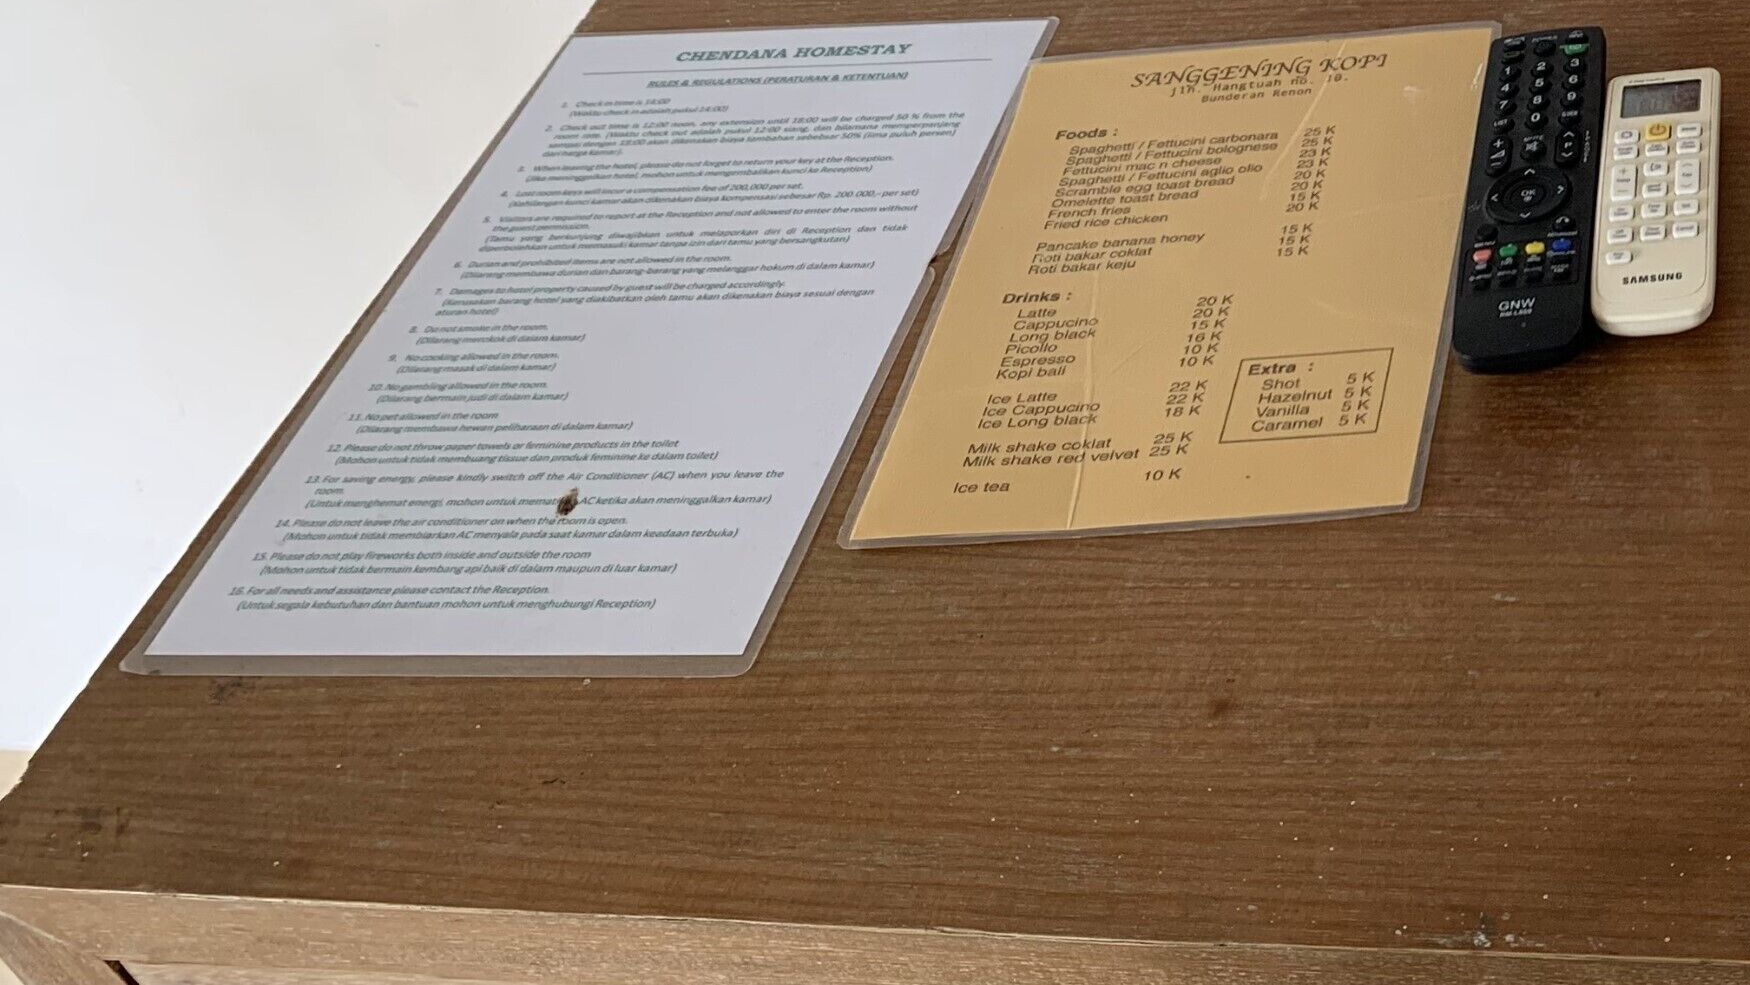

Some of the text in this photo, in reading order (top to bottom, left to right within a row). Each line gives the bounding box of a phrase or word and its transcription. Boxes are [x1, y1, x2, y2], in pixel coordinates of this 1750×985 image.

[675, 43, 913, 63] CHENDANA HOMESTAY
[1129, 53, 1389, 89] SANGGENING KOPI
[1505, 58, 1580, 75] 1 2 3
[645, 79, 681, 89] RULES
[688, 76, 763, 88] REGULATIONS
[762, 74, 830, 85] (PERATURAN
[842, 71, 910, 83] KETENTUAN)
[1212, 78, 1283, 92] Hangtuah
[1500, 75, 1578, 92] 4 5 6
[1200, 87, 1313, 104] Bunderan Renon
[1500, 92, 1576, 110] 7 8 9
[1531, 112, 1541, 122] 0
[1054, 127, 1109, 141] Foods
[1068, 141, 1136, 157] Spaghetti
[1146, 136, 1207, 150] Fettucini
[1208, 132, 1279, 145] carbonara
[1064, 151, 1133, 167] Spaghetti
[1143, 147, 1204, 161] Fettucini
[1205, 142, 1279, 156] bolognese
[1058, 173, 1126, 188] Spaghetti
[1137, 169, 1197, 182] Fettucini
[1199, 165, 1235, 178] aglio
[1238, 163, 1264, 175] olio
[1062, 157, 1223, 177] Fettucini mac n cheese
[1054, 174, 1236, 198] Scramble egg toast bread
[1050, 189, 1200, 209] Omelette toast bread
[1047, 205, 1132, 220] French fries
[1043, 214, 1169, 231] Fried rice chicken
[1035, 232, 1206, 253] Pancake banana honey
[1031, 246, 1153, 265] Roti bakar coklat
[1027, 260, 1137, 276] Roti bakar keju
[1621, 272, 1684, 286] SAMSUNG
[1001, 290, 1062, 305] Drinks
[1497, 297, 1536, 310] GNW
[1016, 307, 1058, 320] Latte
[1012, 316, 1100, 332] Cappucino
[1008, 327, 1097, 344] Long black
[1004, 342, 1059, 356] Picollo
[999, 354, 1077, 369] Espresso
[1247, 362, 1297, 377] Extra
[995, 364, 1068, 382] Kopi bali
[1261, 370, 1376, 392] Shot 5 K
[986, 391, 1059, 405] Ice Latte
[1257, 385, 1373, 405] Hazelnut 5 K
[981, 402, 1101, 418] Ice Cappucino
[1256, 398, 1371, 419] Vanilla 5 K
[977, 412, 1098, 430] Ice Long black
[1250, 412, 1368, 433] Caramel 5 K
[967, 430, 1194, 455] Milk shake coklat 25 K
[961, 442, 1190, 468] Milk shake red velvet 25 K
[321, 475, 341, 484] For
[341, 476, 377, 485] saving
[377, 475, 417, 485] energy,
[416, 474, 455, 484] please
[455, 472, 490, 484] kindly
[490, 472, 526, 482] switch
[527, 471, 546, 482] off
[545, 472, 566, 481] the
[565, 472, 584, 481] Air
[585, 471, 650, 481] Conditioner
[650, 470, 676, 482] (AC)
[677, 470, 708, 480] when
[710, 471, 732, 481] you
[732, 469, 764, 479] leave
[765, 469, 785, 479] the
[952, 467, 1183, 495] Ice tea 10 K
[269, 552, 306, 561] Please
[304, 552, 322, 561] do
[319, 552, 342, 561] not
[338, 551, 365, 562] play
[364, 550, 416, 561] fireworks
[415, 551, 444, 561] both
[442, 550, 477, 560] inside
[475, 550, 501, 560] and
[498, 550, 542, 560] outside
[541, 550, 561, 560] the
[560, 551, 592, 559] room
